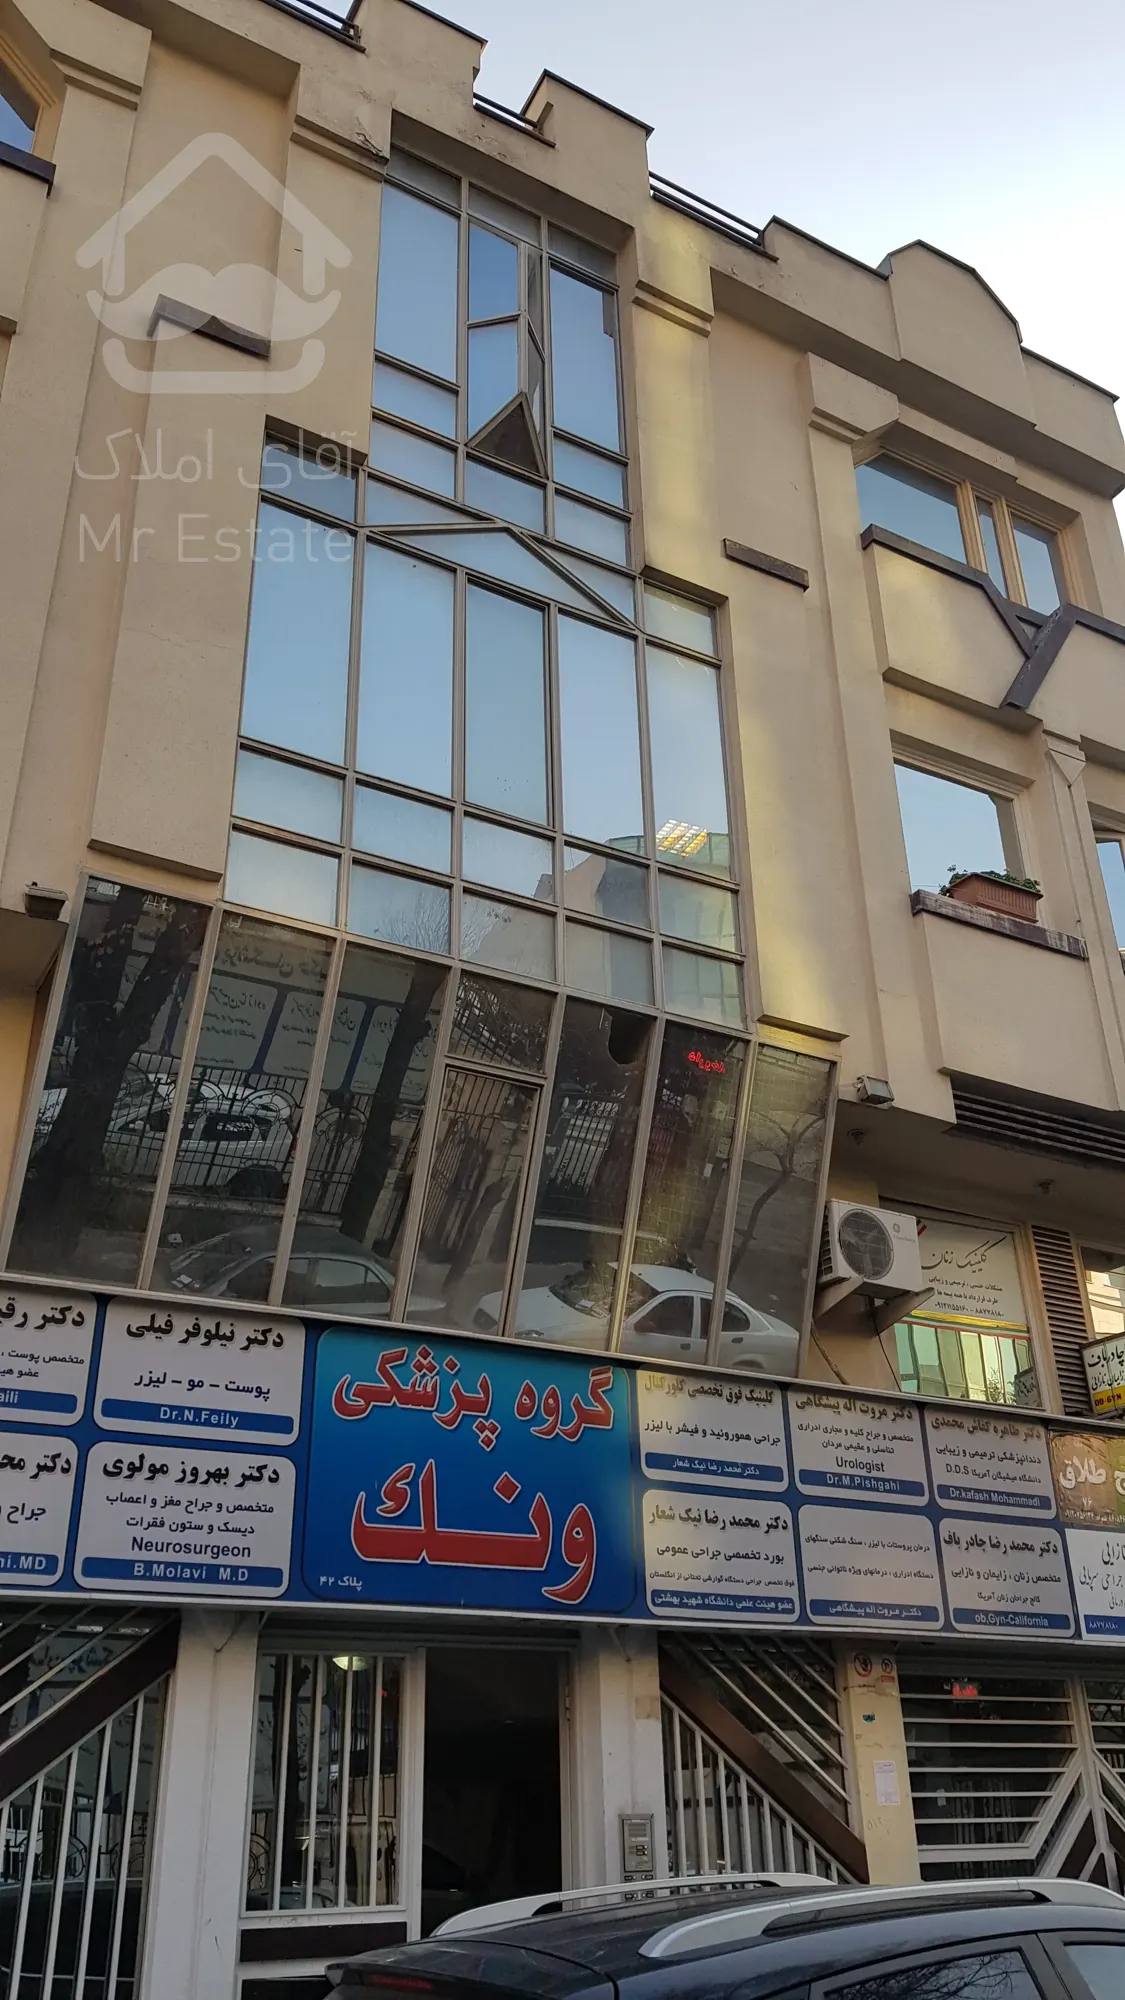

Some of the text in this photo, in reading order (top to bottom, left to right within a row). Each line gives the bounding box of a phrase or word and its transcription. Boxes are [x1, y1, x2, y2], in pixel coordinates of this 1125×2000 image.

[921, 1236, 1007, 1273] کلینیک زنان
[34, 1306, 85, 1329] دکتر
[126, 1313, 284, 1350] دکتر نیلوفر فیلی
[8, 1350, 84, 1364] متخصص پوست
[17, 1368, 39, 1378] عضو
[134, 1371, 271, 1401] پوست مو لیزر
[0, 1391, 18, 1404] aili
[332, 1344, 614, 1452] گروه پزشکی
[688, 1383, 773, 1406] کلینیک فوق تخصصی
[795, 1394, 912, 1421] دکتر مروت اله پیشگاهی
[160, 1407, 239, 1429] Dr.N.Feily
[645, 1420, 780, 1446] جراحی فیشر با لیزر
[798, 1423, 820, 1432] ادراری
[823, 1425, 842, 1434] مجاری
[850, 1428, 864, 1436] کلیه
[866, 1430, 880, 1440] جراح
[931, 1415, 1041, 1442] دکتر طاهره کفاش محمدی
[822, 1440, 894, 1454] تناسلی عقیمی مردان
[936, 1444, 1041, 1465] دندانپزشکی ترمیمی زیبایی
[29, 1453, 71, 1479] دکتر
[103, 1453, 280, 1487] دکتر بهروز مولوی
[673, 1458, 759, 1476] دکتر محمد رضا نیک شعار
[836, 1456, 885, 1473] Urologist
[1060, 1456, 1106, 1488] طلاق
[827, 1474, 900, 1491] Dr.M.Pishgahi
[106, 1493, 146, 1506] اعصاب
[160, 1496, 181, 1509] مغز
[950, 1487, 1040, 1507] Dr.kafash Mohammadi
[7, 1503, 46, 1524] جراح
[185, 1498, 213, 1514] جراح
[227, 1501, 274, 1513] متخصص
[126, 1517, 165, 1531] فقرات
[169, 1519, 204, 1533] ستون
[649, 1505, 788, 1533] دکتر محمد رضا نیک شعار
[217, 1521, 255, 1535] دیسک
[943, 1530, 960, 1545] باف
[989, 1535, 1007, 1554] رضا
[131, 1537, 251, 1559] Neurosurgeon
[1009, 1540, 1035, 1554] محمد
[1038, 1541, 1058, 1557] دکتر
[657, 1546, 784, 1565] بورد تخصصی جراحی عمومی
[133, 1563, 248, 1582] B.Molavi M.D
[951, 1567, 974, 1577] نازایی
[982, 1570, 1007, 1581] زایمان
[1014, 1574, 1030, 1583] زنان
[319, 1576, 363, 1591] پلاک ۴۲
[655, 1593, 680, 1603] بهشتی
[683, 1596, 702, 1605] شهید
[704, 1596, 734, 1606] دانشگاه
[736, 1600, 753, 1609] علمی
[778, 1602, 793, 1610] عضو
